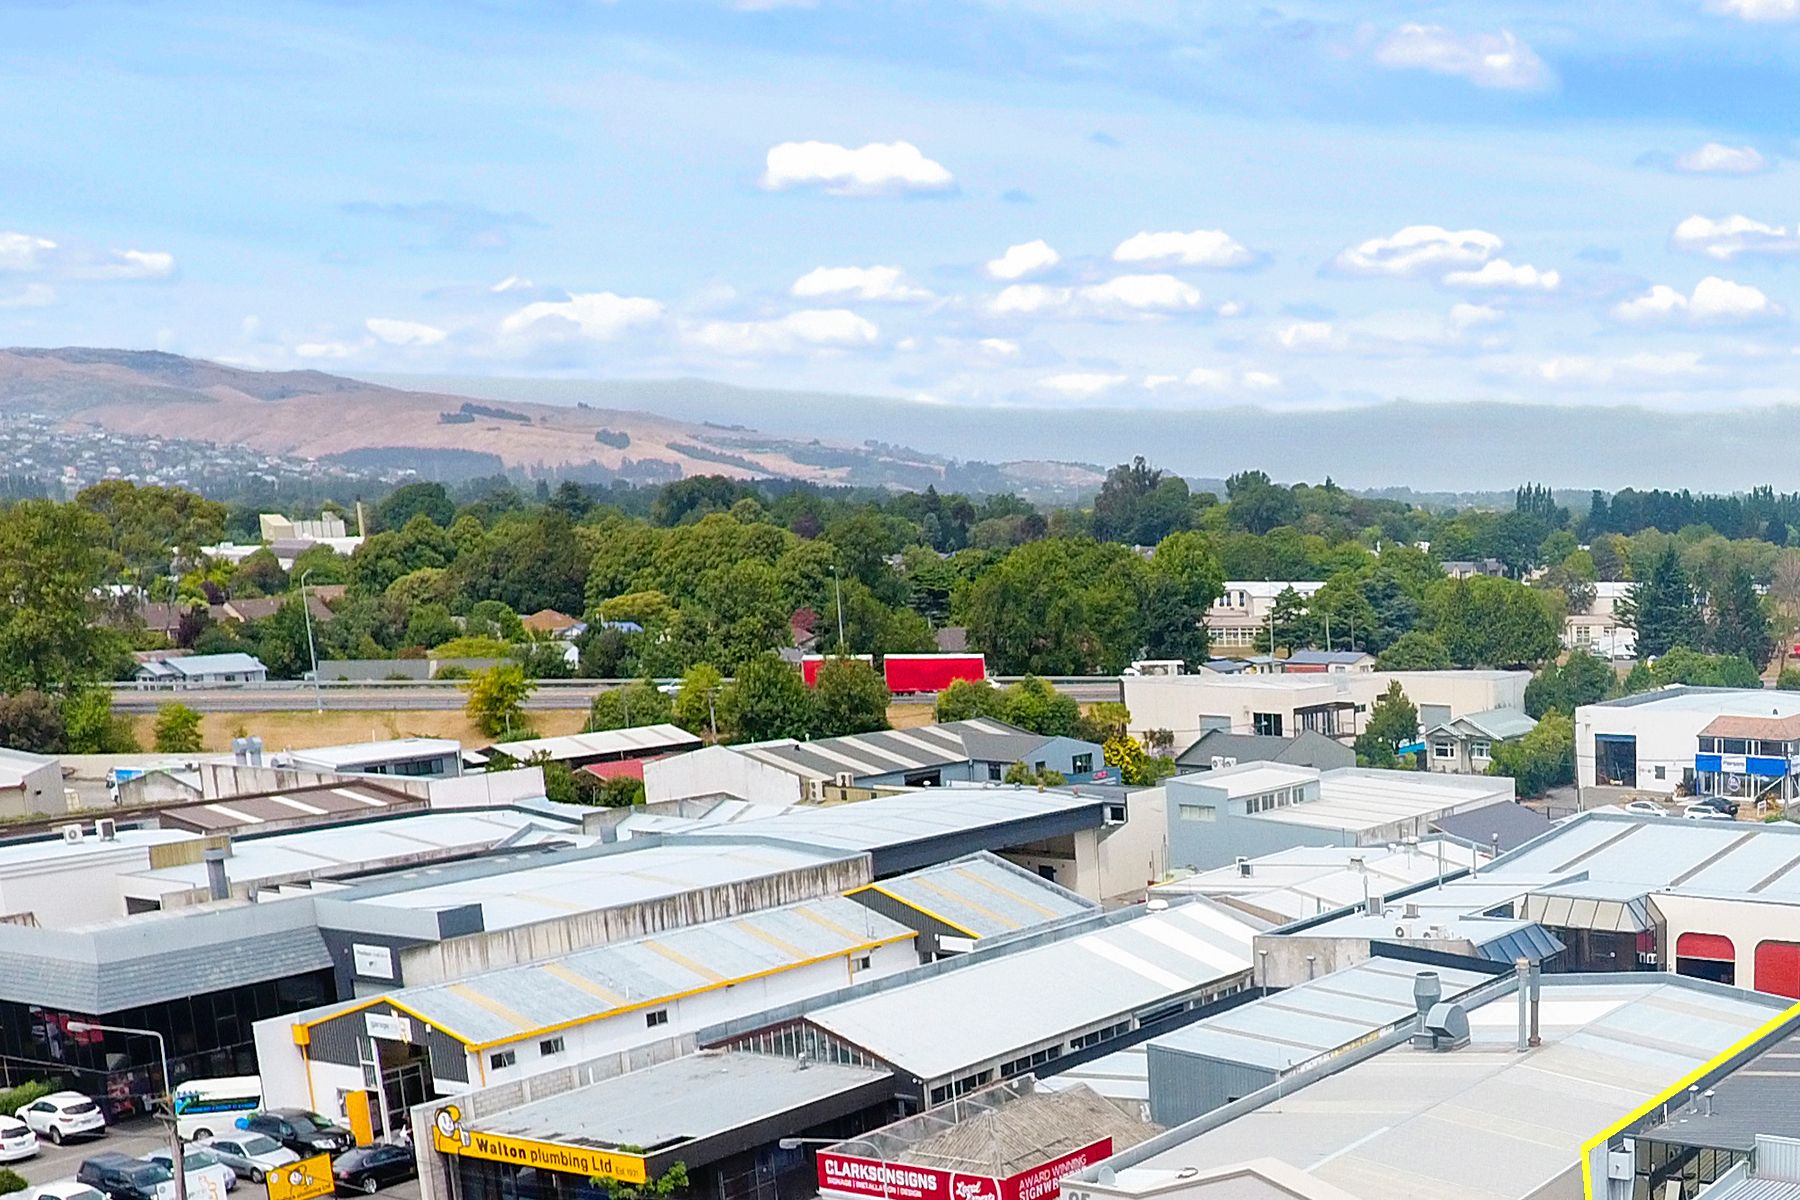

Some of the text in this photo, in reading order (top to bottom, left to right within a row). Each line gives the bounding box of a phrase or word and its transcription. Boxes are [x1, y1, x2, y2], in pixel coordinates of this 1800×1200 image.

[476, 1138, 527, 1160] Walton
[530, 1150, 589, 1173] plumbing
[592, 1157, 612, 1174] Ltd
[1019, 1153, 1087, 1191] AWARD WINNING
[824, 1159, 937, 1191] CLARKSONSIGNS
